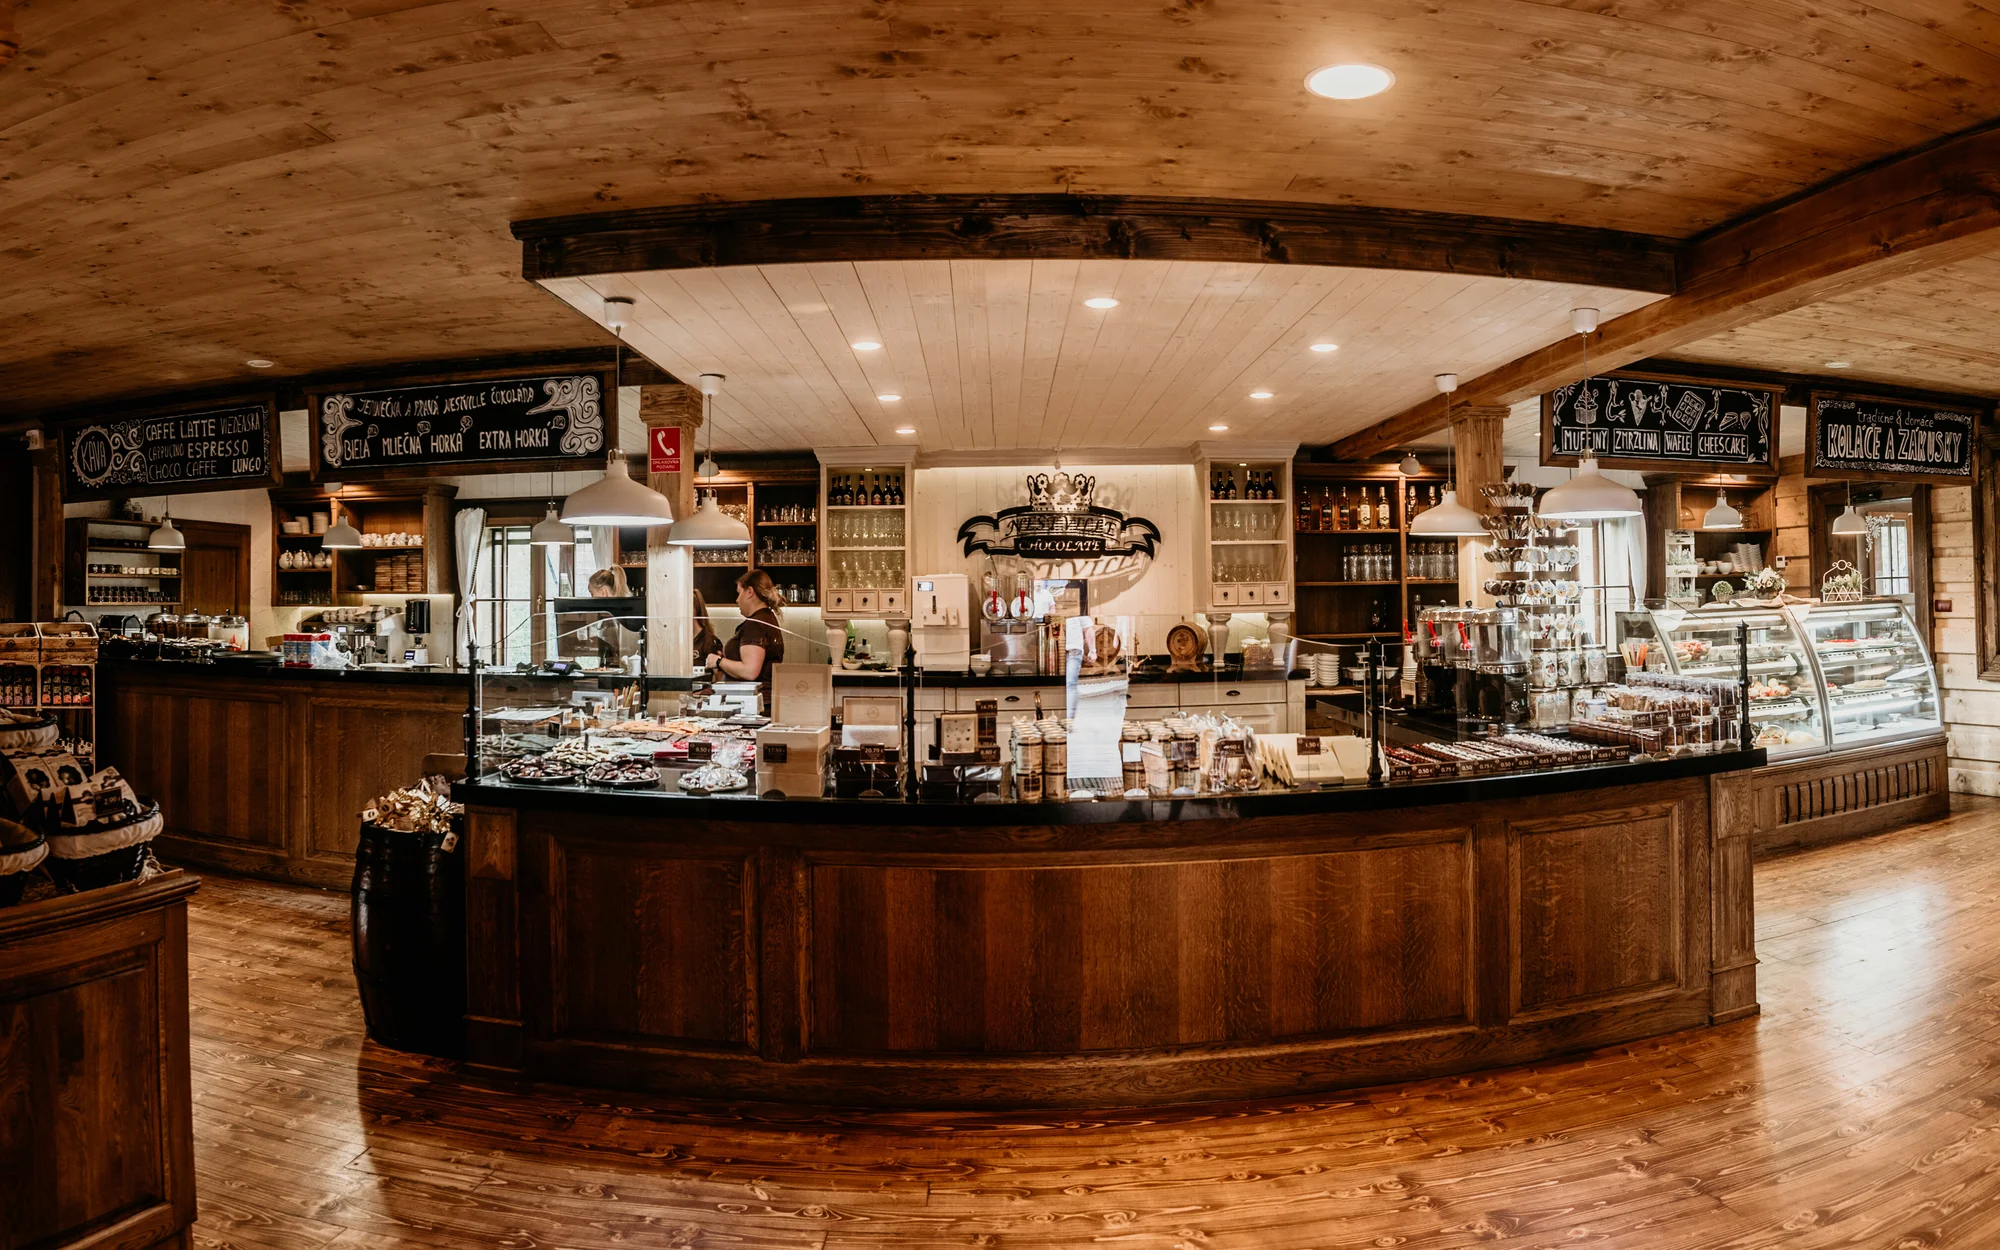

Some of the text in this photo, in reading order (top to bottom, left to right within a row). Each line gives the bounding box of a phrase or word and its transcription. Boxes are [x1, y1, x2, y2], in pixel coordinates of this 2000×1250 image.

[145, 420, 176, 442] CAFFE
[180, 418, 216, 438] LATTE
[343, 438, 371, 461] BIELA
[430, 428, 464, 453] HORKÁ
[479, 430, 512, 450] EXTRA
[515, 421, 552, 448] HORKÁ
[1615, 430, 1659, 450] ZMRZLINA
[1665, 431, 1691, 451] WAFLE
[80, 435, 107, 472] KÁVA
[187, 439, 249, 459] ESPRESSO
[1827, 422, 1963, 463] KOLÁČE A ZÁKUSKY
[149, 457, 262, 480] CHOCO CAFFE LUNGO
[1005, 515, 1118, 536] NESTVILLE
[1019, 539, 1101, 552] CHOCOLATE
